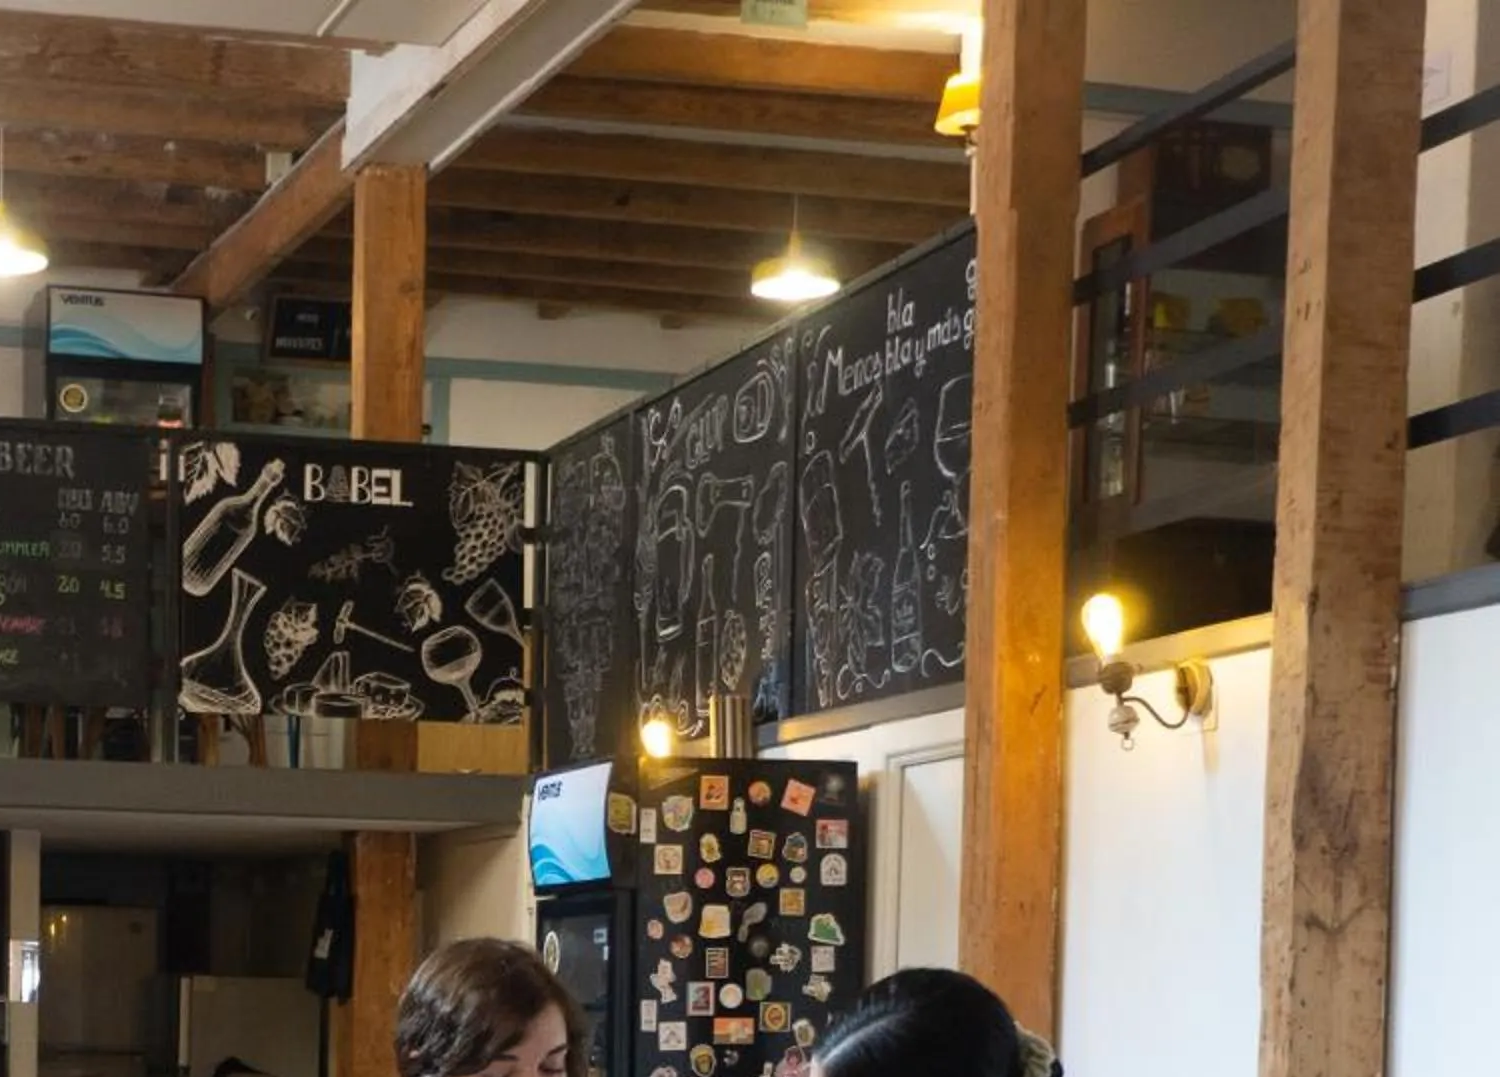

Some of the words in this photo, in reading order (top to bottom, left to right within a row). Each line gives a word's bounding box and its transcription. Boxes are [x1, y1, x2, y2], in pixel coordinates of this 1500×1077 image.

[887, 287, 916, 334] bla
[826, 344, 883, 397] Menos
[885, 336, 913, 375] bla
[303, 463, 414, 507] BABEL
